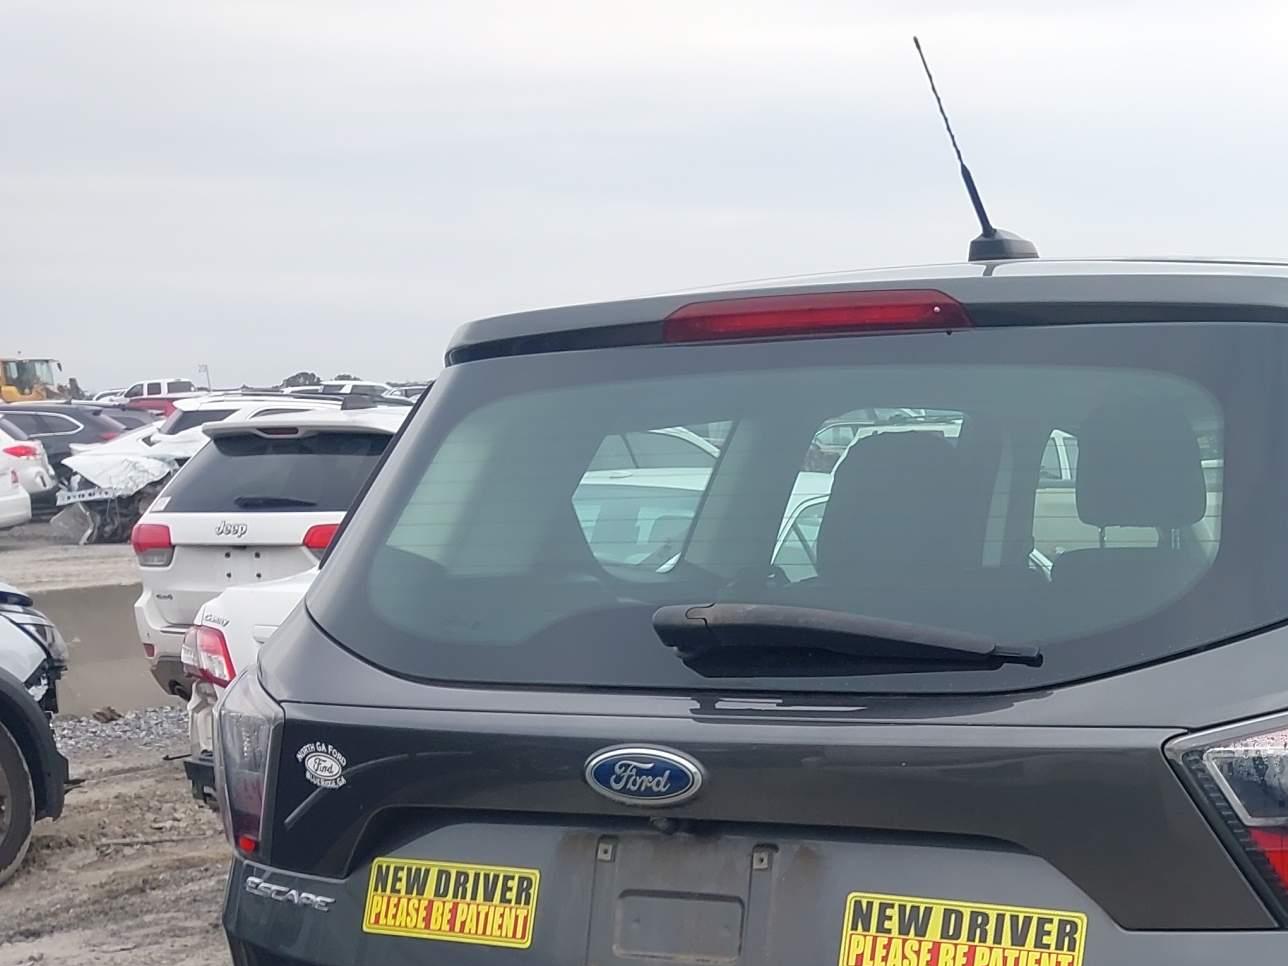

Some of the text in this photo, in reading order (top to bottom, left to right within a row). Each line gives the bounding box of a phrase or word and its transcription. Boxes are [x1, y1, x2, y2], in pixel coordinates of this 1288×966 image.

[216, 521, 247, 538] Jeep
[296, 741, 347, 767] NORTH GA FORD
[610, 760, 671, 792] Ford
[246, 876, 336, 912] ESCAPE
[373, 864, 533, 906] NEW DRIVER
[370, 894, 528, 939] PLEASE BE PATIENT
[850, 899, 1079, 952] NEW DRIVER
